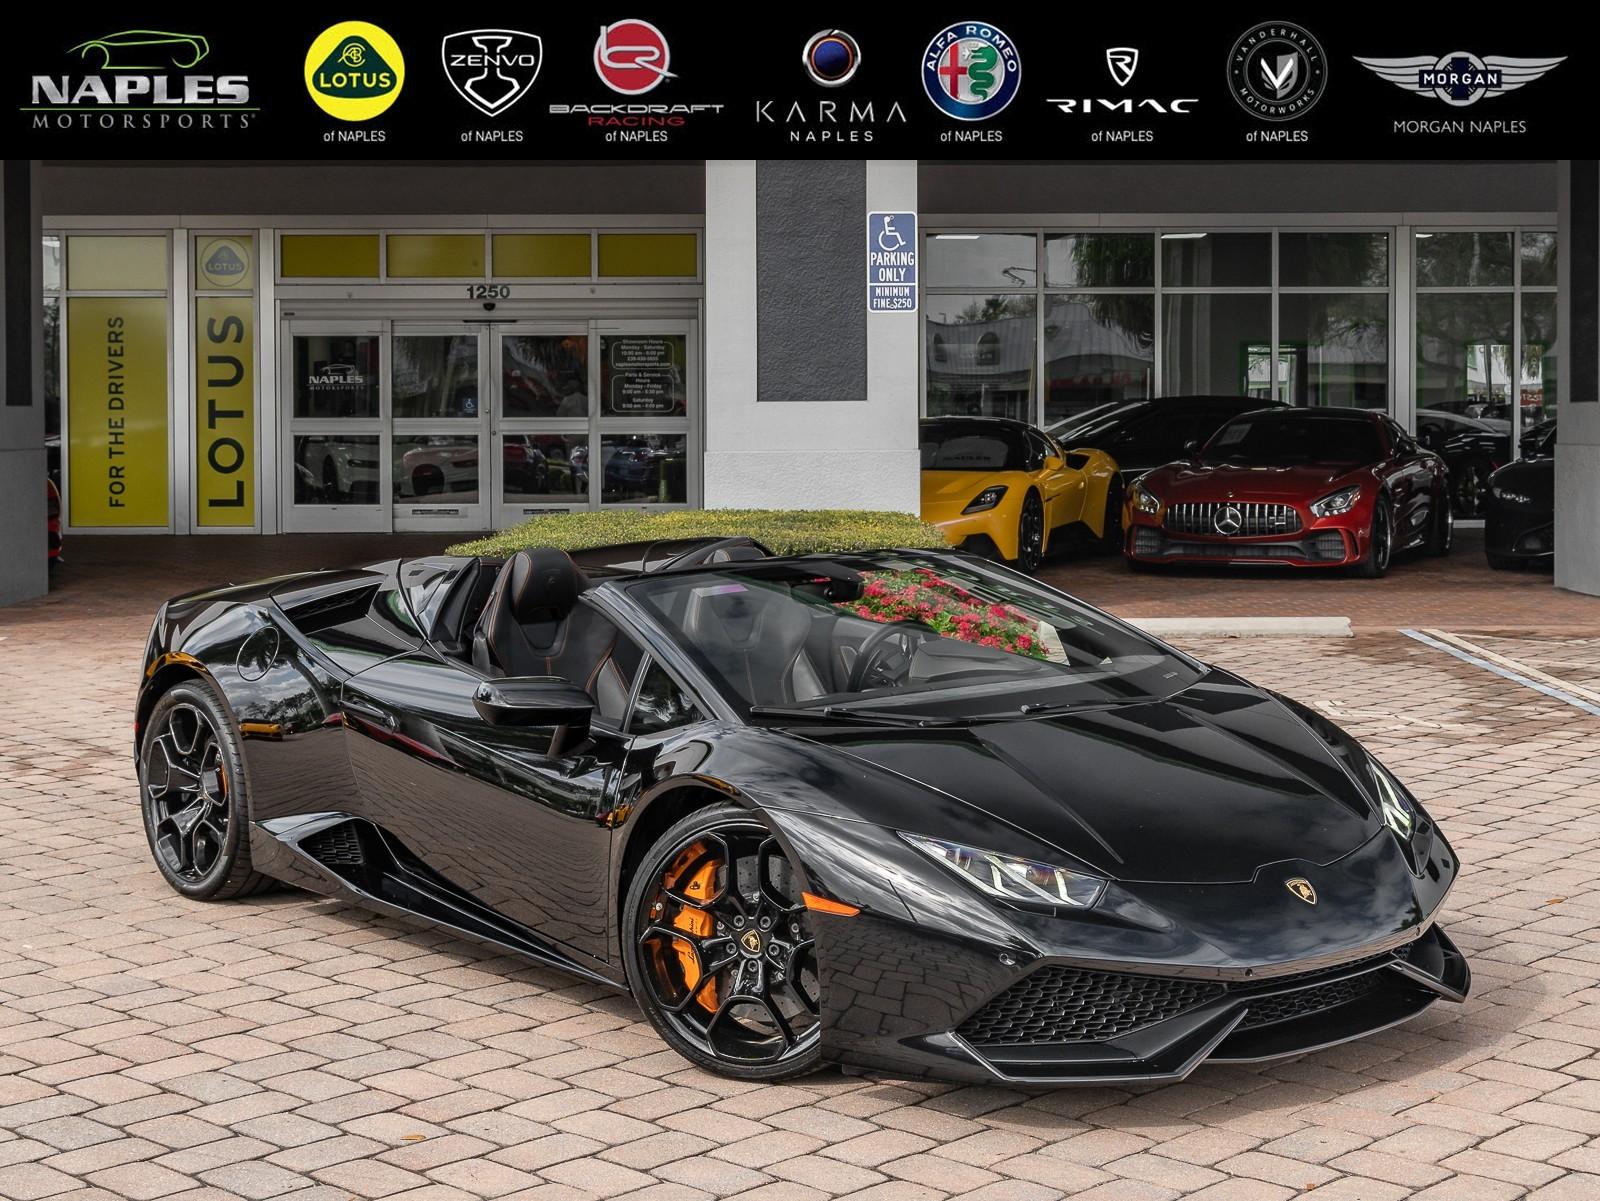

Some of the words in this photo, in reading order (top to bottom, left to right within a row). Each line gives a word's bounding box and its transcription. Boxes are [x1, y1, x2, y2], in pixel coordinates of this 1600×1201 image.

[870, 251, 915, 266] PARKING
[208, 263, 242, 271] LOTUS
[878, 267, 906, 282] ONLY
[466, 284, 511, 299] 1250
[875, 286, 910, 297] MINIMUM
[107, 316, 125, 411] DRIVERS
[309, 375, 364, 384] NAPLES
[207, 315, 245, 508] LOTUS
[108, 416, 125, 460] THE
[109, 465, 126, 508] FOR
